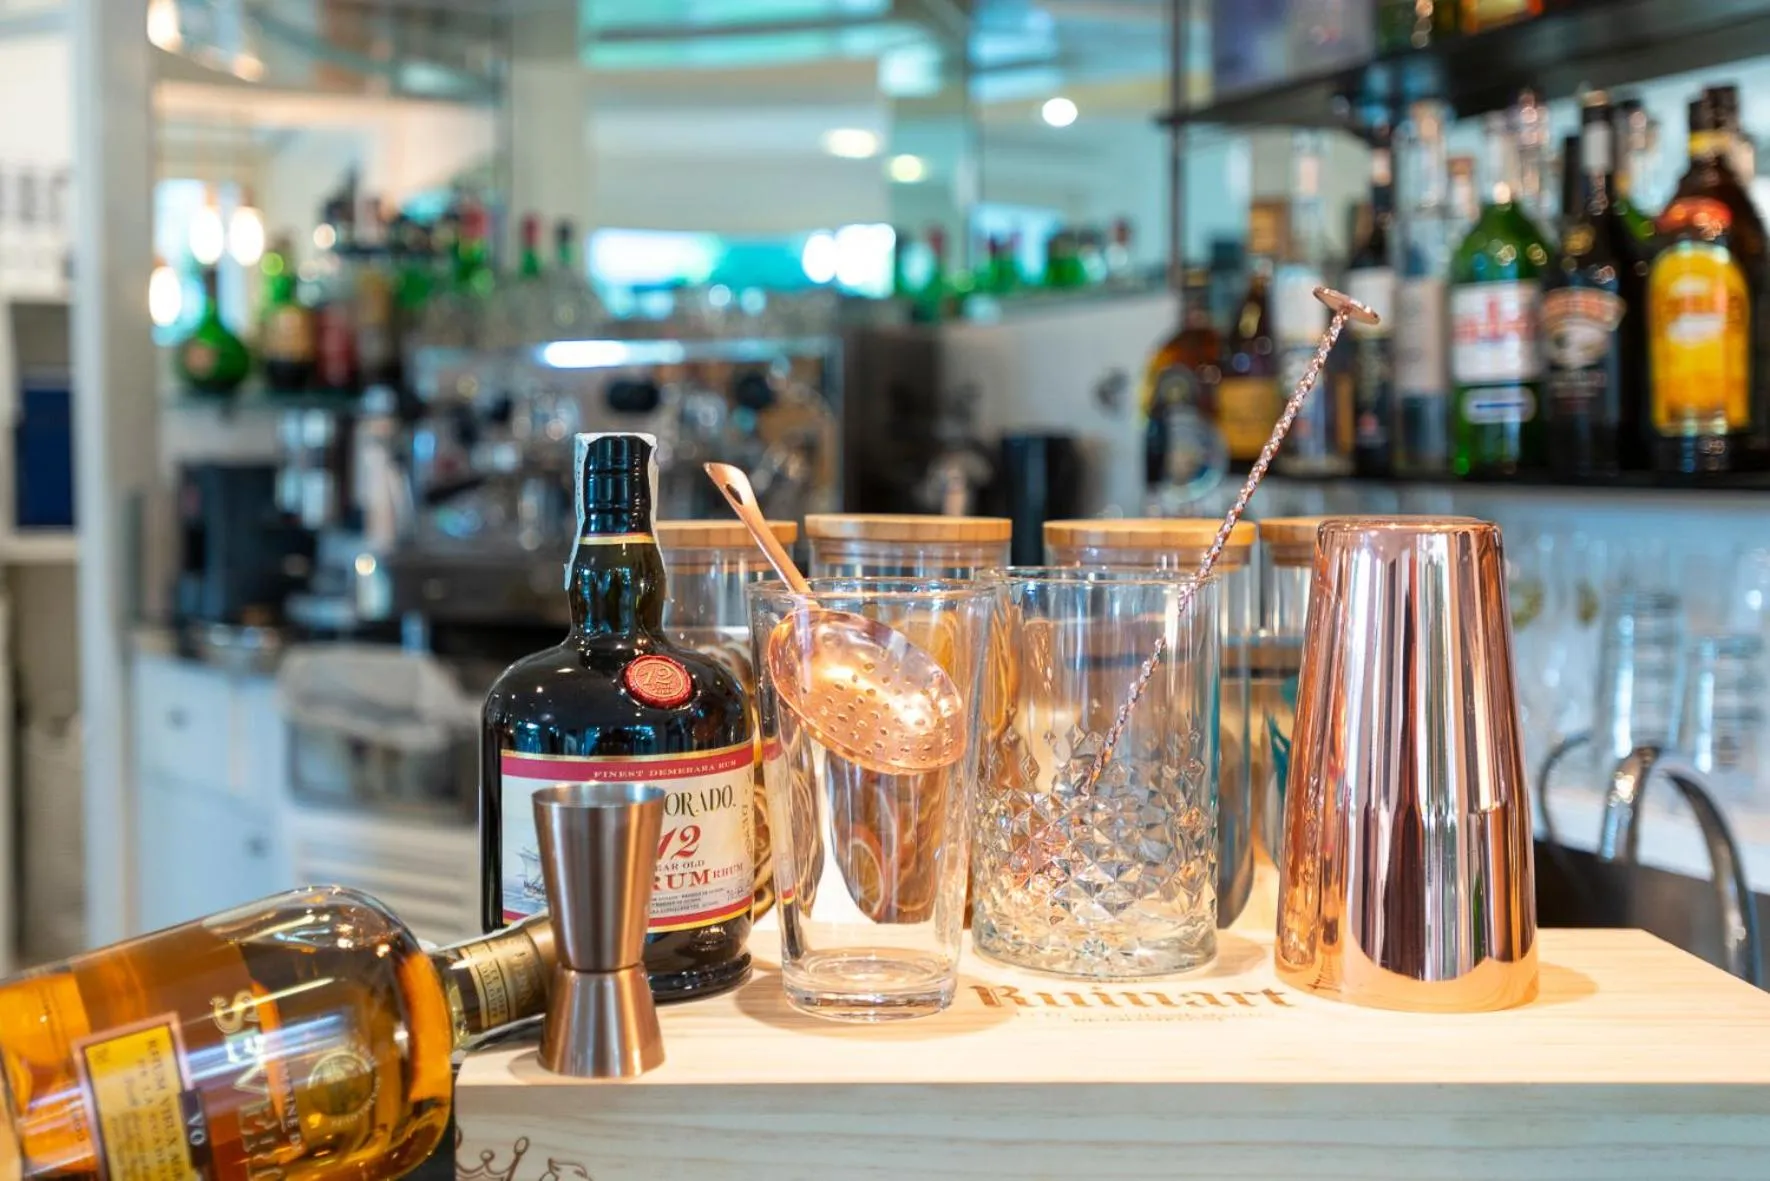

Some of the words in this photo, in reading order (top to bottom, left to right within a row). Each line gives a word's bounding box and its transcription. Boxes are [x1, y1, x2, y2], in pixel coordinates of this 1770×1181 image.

[593, 770, 644, 779] FINEST
[718, 759, 737, 770] RUM
[656, 823, 701, 860] 12
[655, 862, 679, 873] EAR
[682, 859, 706, 869] OLD
[713, 862, 744, 879] RHUM
[969, 985, 1294, 1008] Ruinart
[187, 1110, 207, 1146] VO
